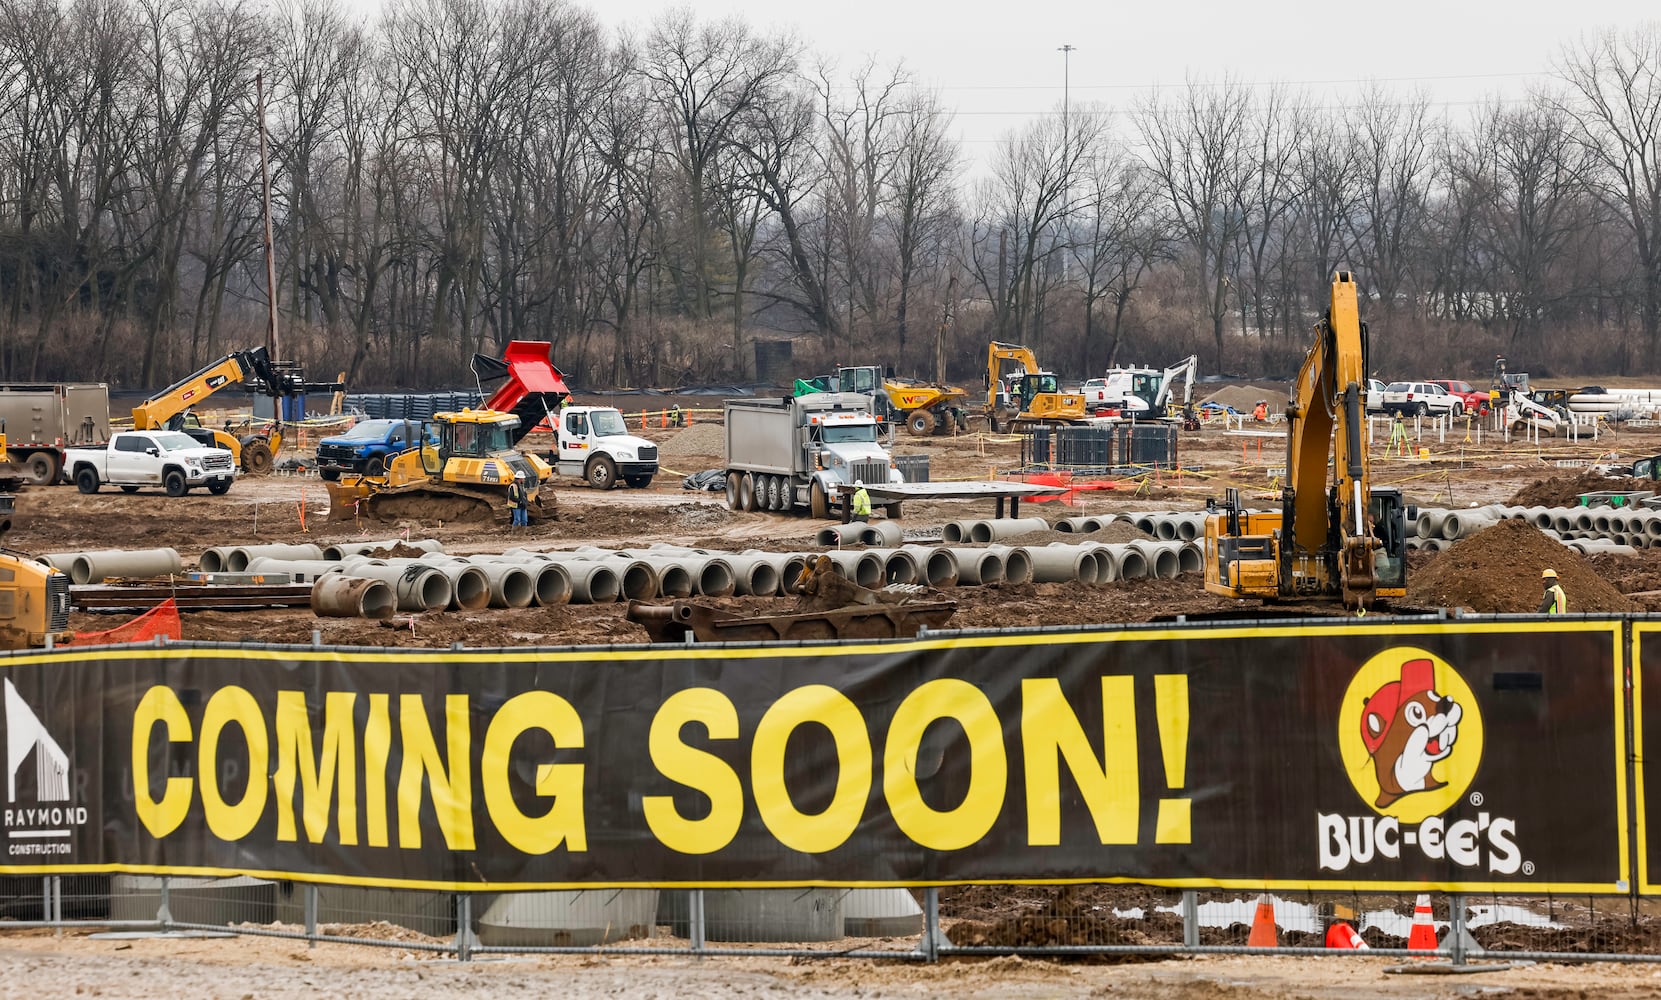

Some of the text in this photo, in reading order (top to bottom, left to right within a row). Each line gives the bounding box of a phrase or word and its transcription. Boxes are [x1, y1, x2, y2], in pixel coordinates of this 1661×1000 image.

[132, 674, 1192, 855] COMING SOON!
[4, 807, 88, 827] RAYMOND
[8, 843, 72, 856] CONSTRUCTION
